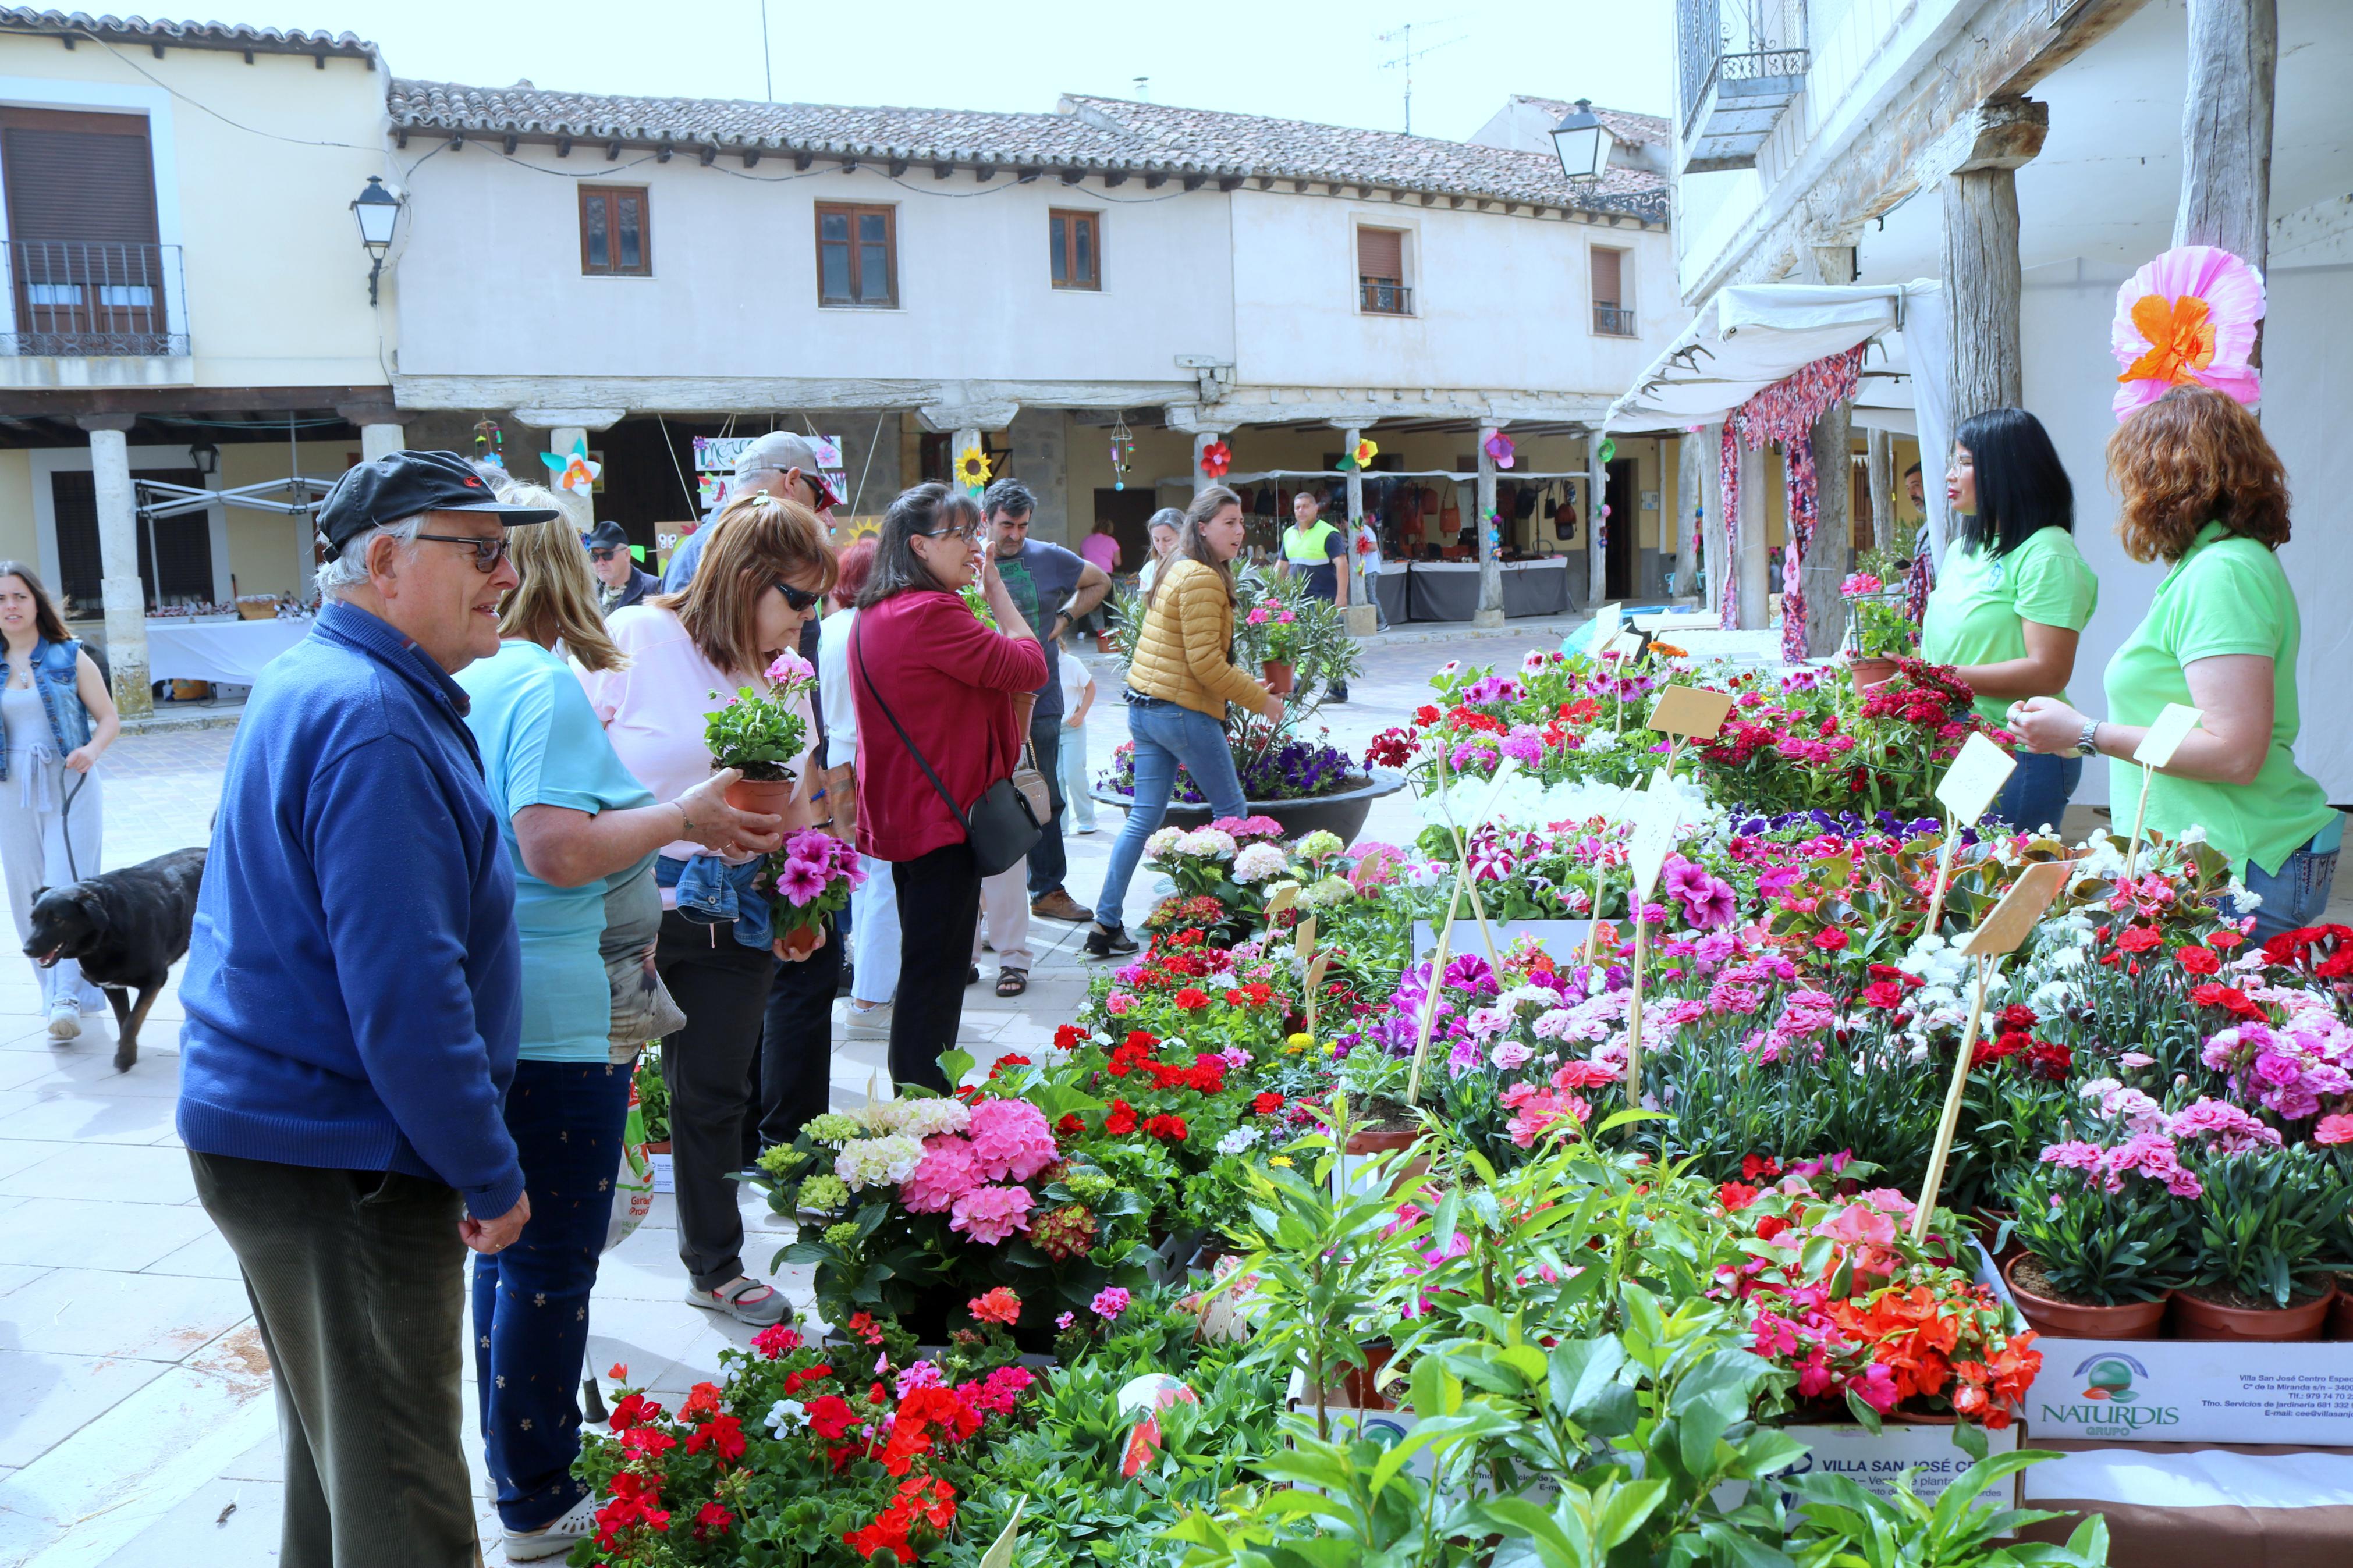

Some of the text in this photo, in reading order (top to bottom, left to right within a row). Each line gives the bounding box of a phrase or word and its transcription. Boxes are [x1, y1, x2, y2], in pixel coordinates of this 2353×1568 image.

[2041, 1404, 2179, 1430] NATURDIS
[2086, 1427, 2130, 1436] GRUPO
[1822, 1460, 1867, 1471] VILLA
[1871, 1460, 1904, 1472] SAN
